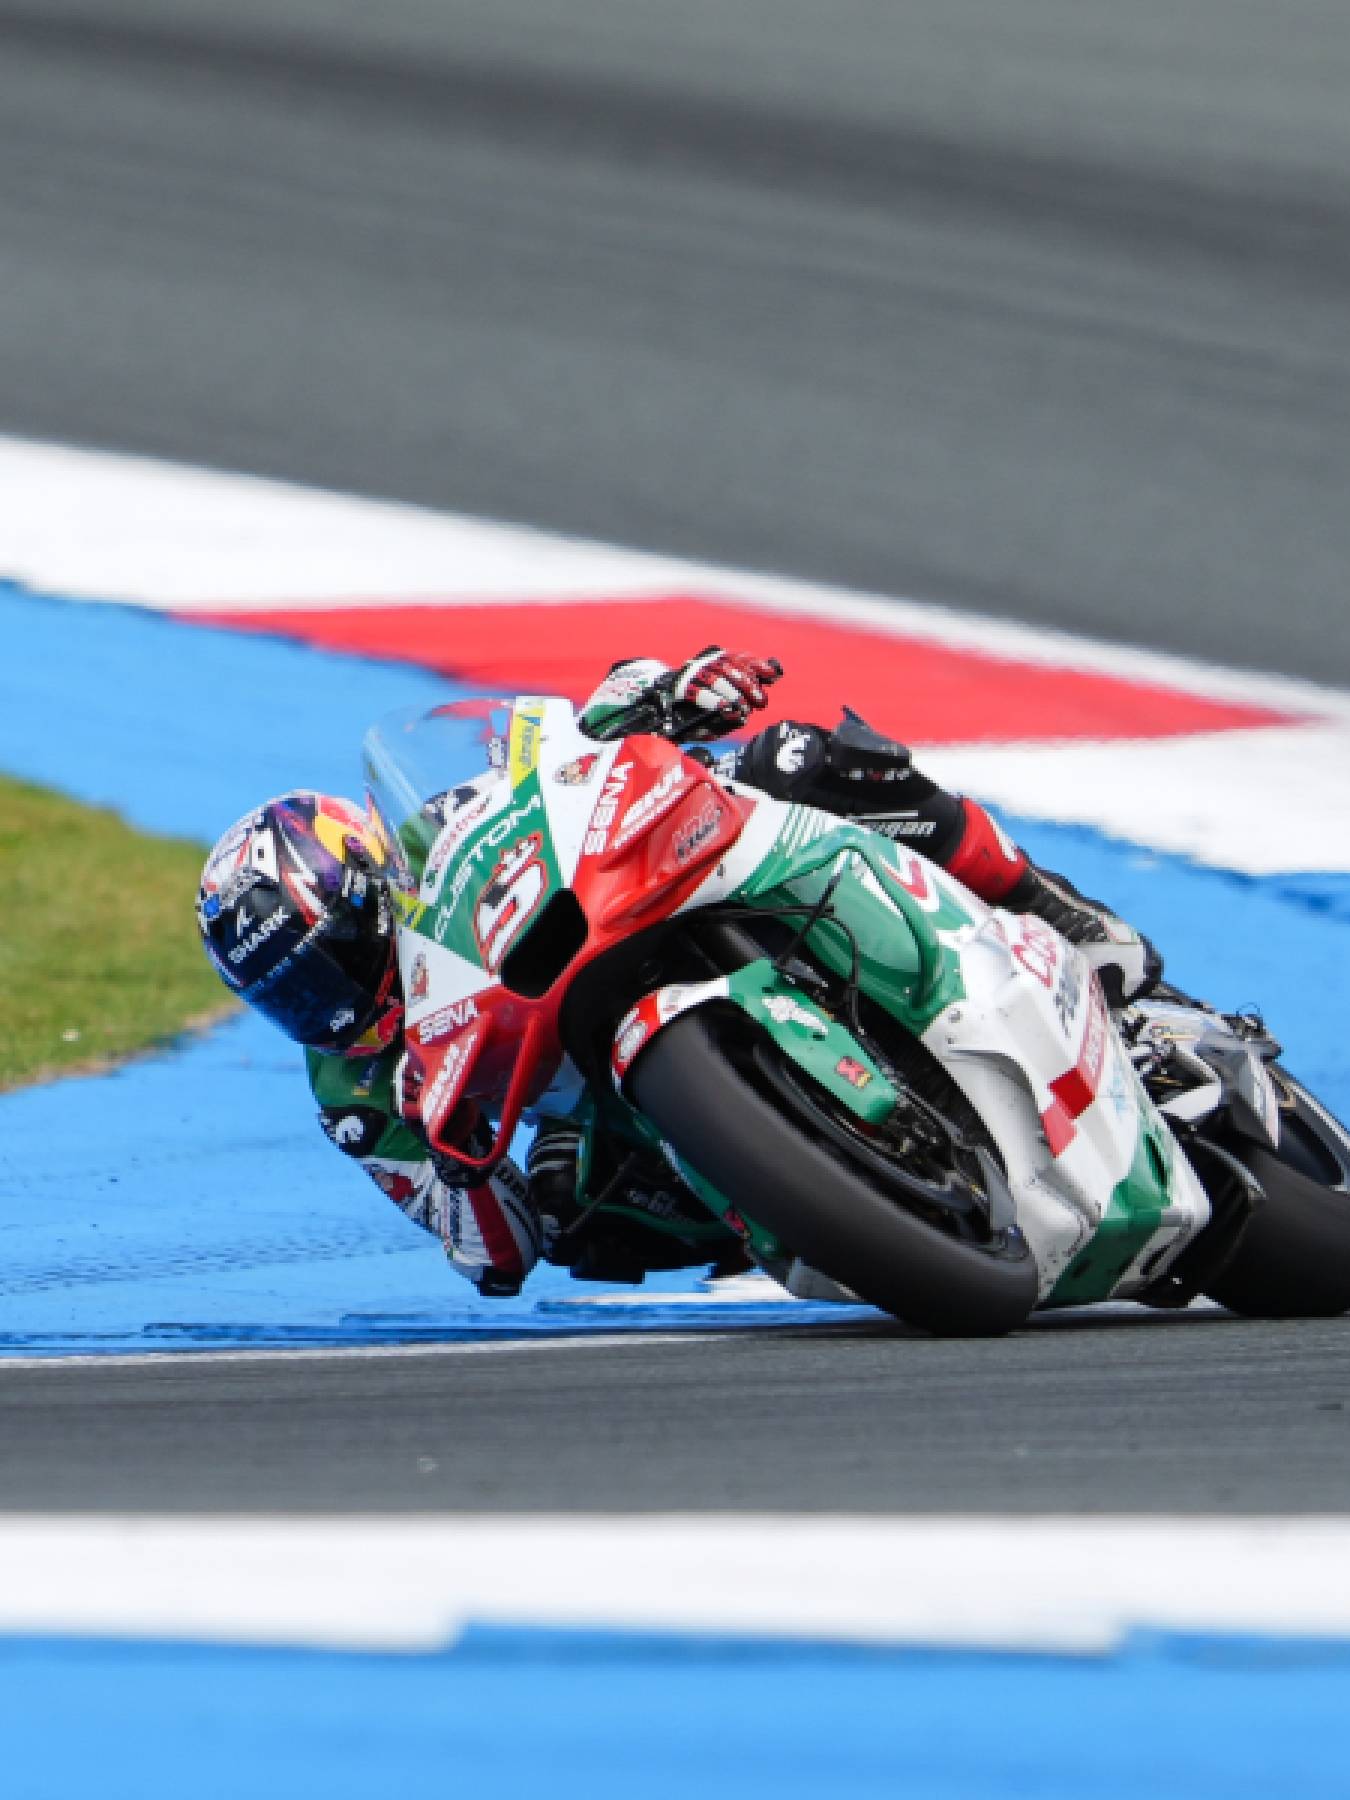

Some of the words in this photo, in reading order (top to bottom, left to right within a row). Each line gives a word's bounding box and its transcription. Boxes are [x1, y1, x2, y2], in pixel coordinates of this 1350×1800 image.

[584, 761, 634, 856] SENA
[434, 794, 541, 942] CUSTOM
[227, 906, 291, 964] SHARK
[419, 998, 479, 1045] SENA
